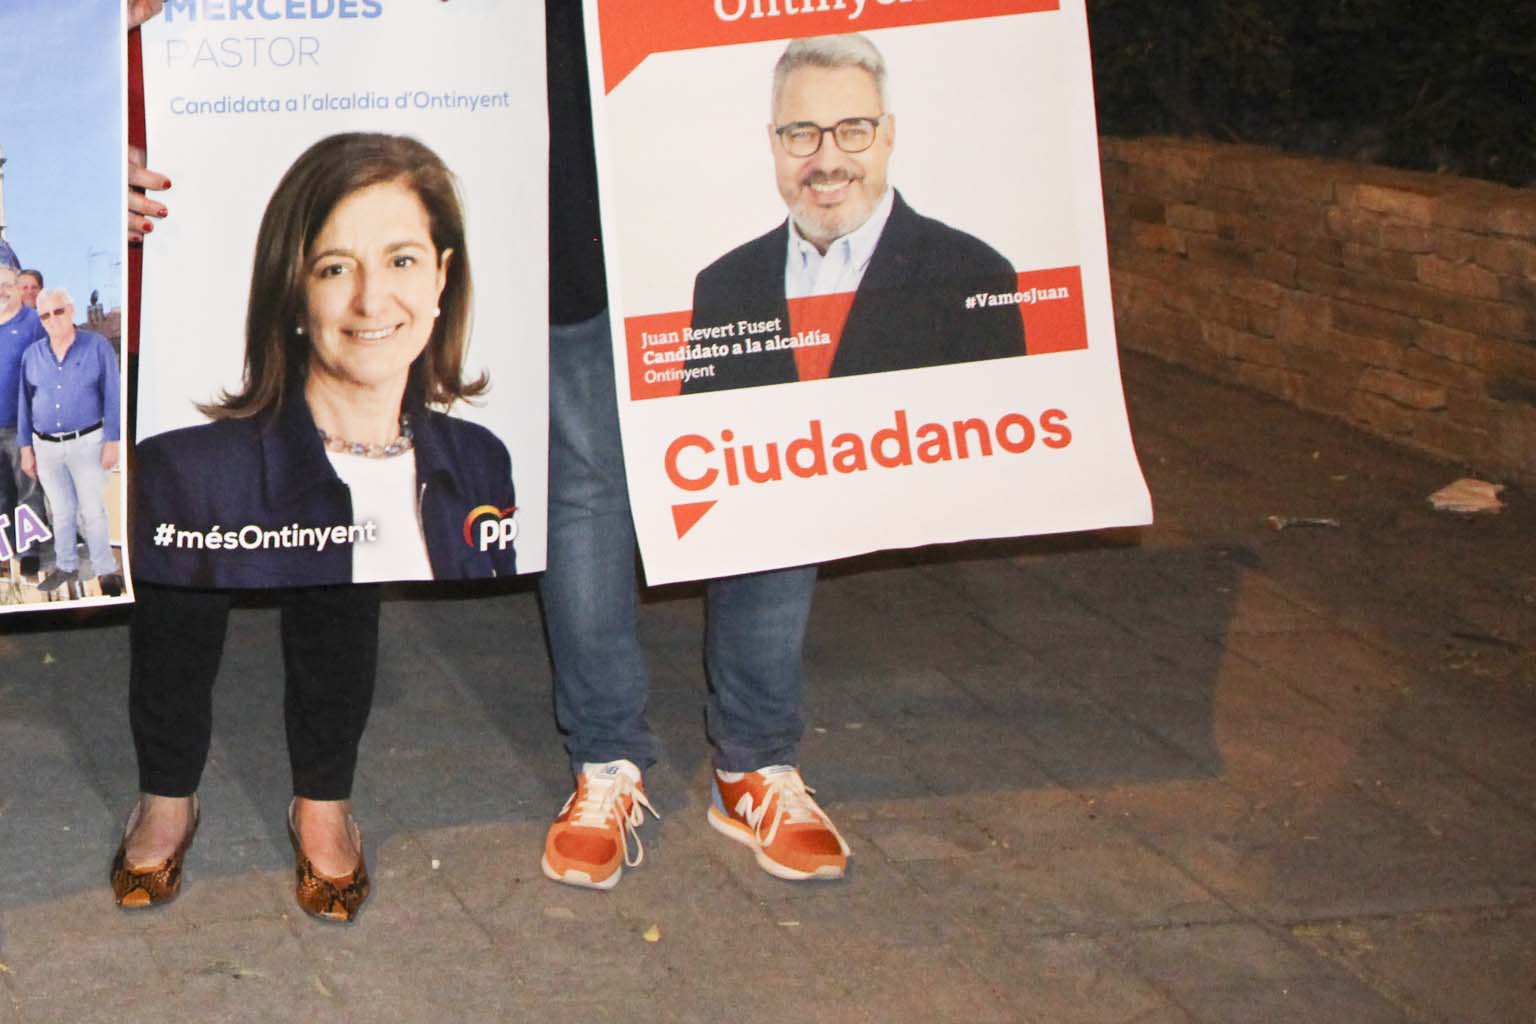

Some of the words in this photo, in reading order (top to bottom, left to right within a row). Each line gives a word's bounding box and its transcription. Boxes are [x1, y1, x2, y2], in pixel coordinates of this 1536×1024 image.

[165, 36, 321, 69] PASTOR
[170, 93, 280, 115] Candidata
[285, 97, 298, 113] a
[302, 92, 389, 112] l'alcaldia
[395, 90, 510, 113] d'Ontinyent
[964, 286, 1070, 310] #VamosJuan
[641, 332, 679, 350] Juan
[682, 324, 735, 342] Revert
[737, 317, 782, 335] Fuset
[642, 342, 730, 365] Candidato
[732, 342, 743, 355] a
[745, 337, 763, 353] la
[764, 329, 831, 351] alcaldía
[644, 363, 716, 385] Ontinyent
[664, 407, 1073, 492] Ciudadanos
[153, 520, 377, 551] #mésOntinyent
